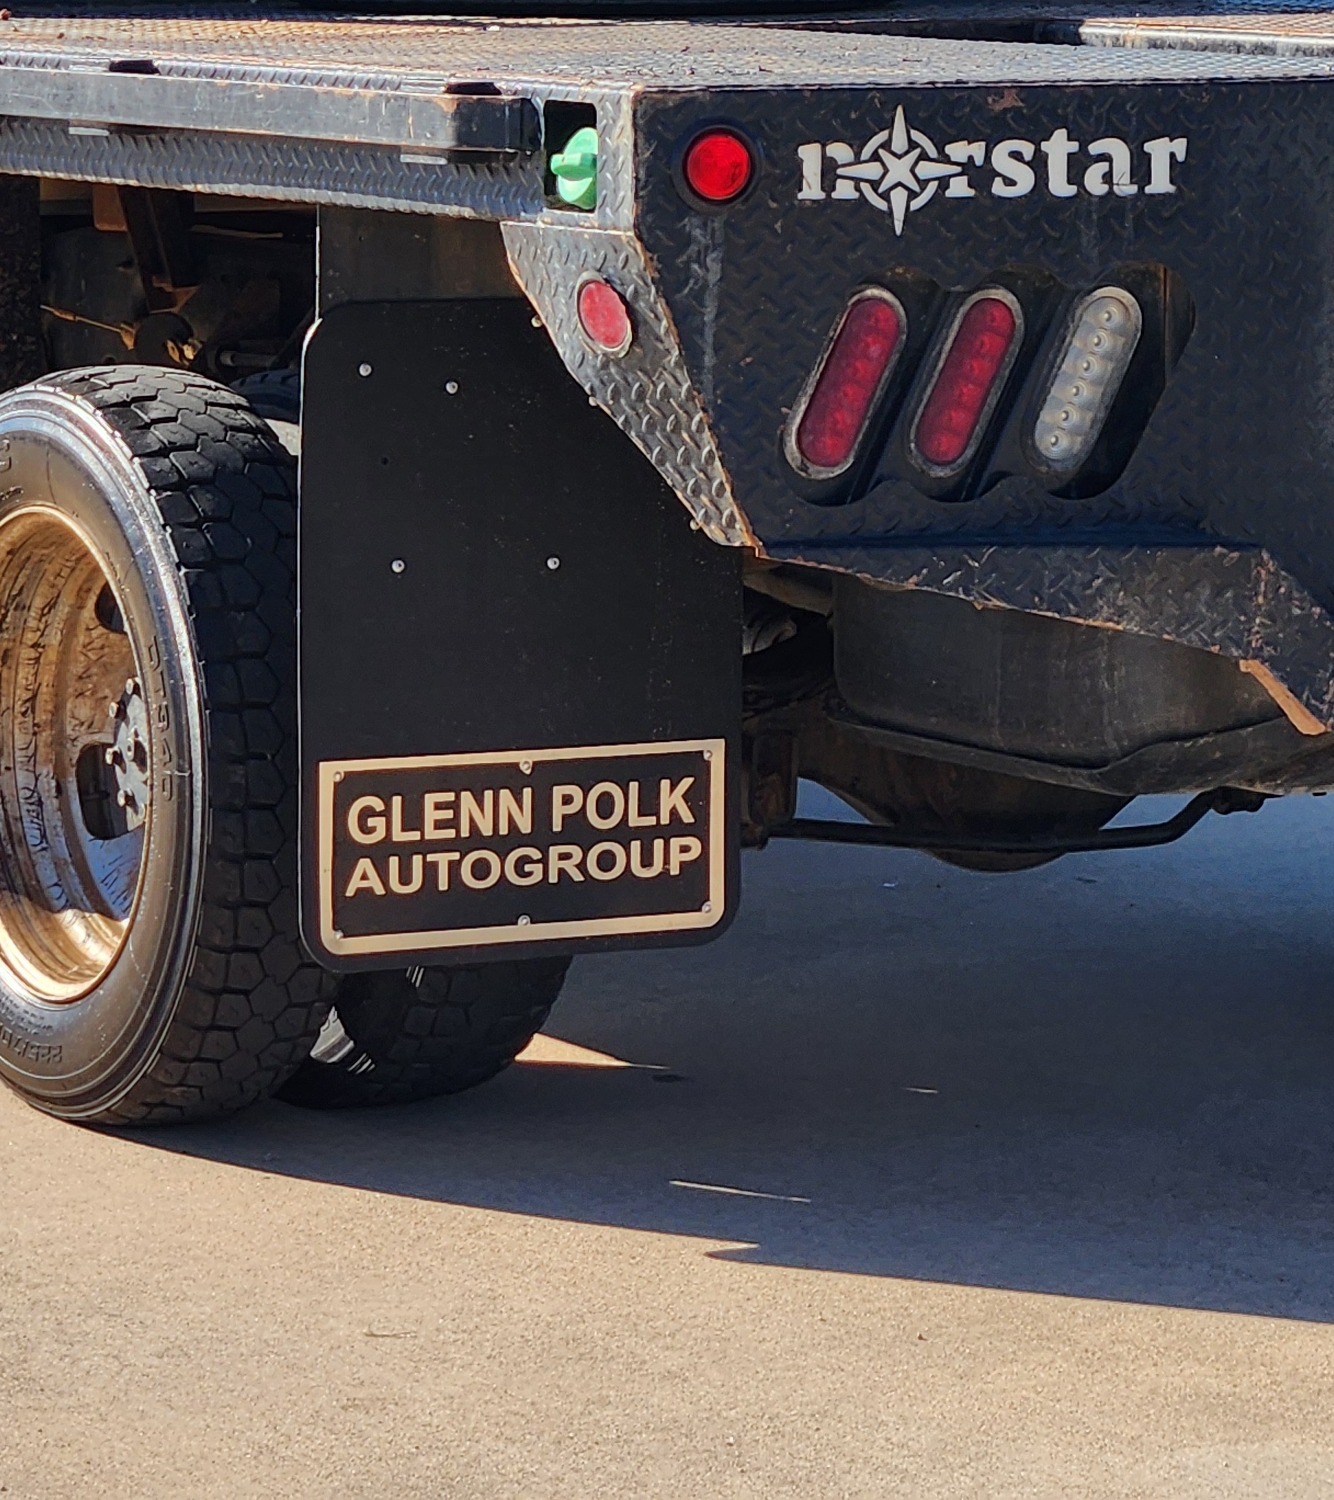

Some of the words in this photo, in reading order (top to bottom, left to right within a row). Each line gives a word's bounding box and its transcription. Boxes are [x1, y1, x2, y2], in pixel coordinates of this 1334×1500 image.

[347, 786, 533, 845] GLENN
[552, 776, 695, 832] POLK
[345, 835, 703, 897] AUTOGROUP
